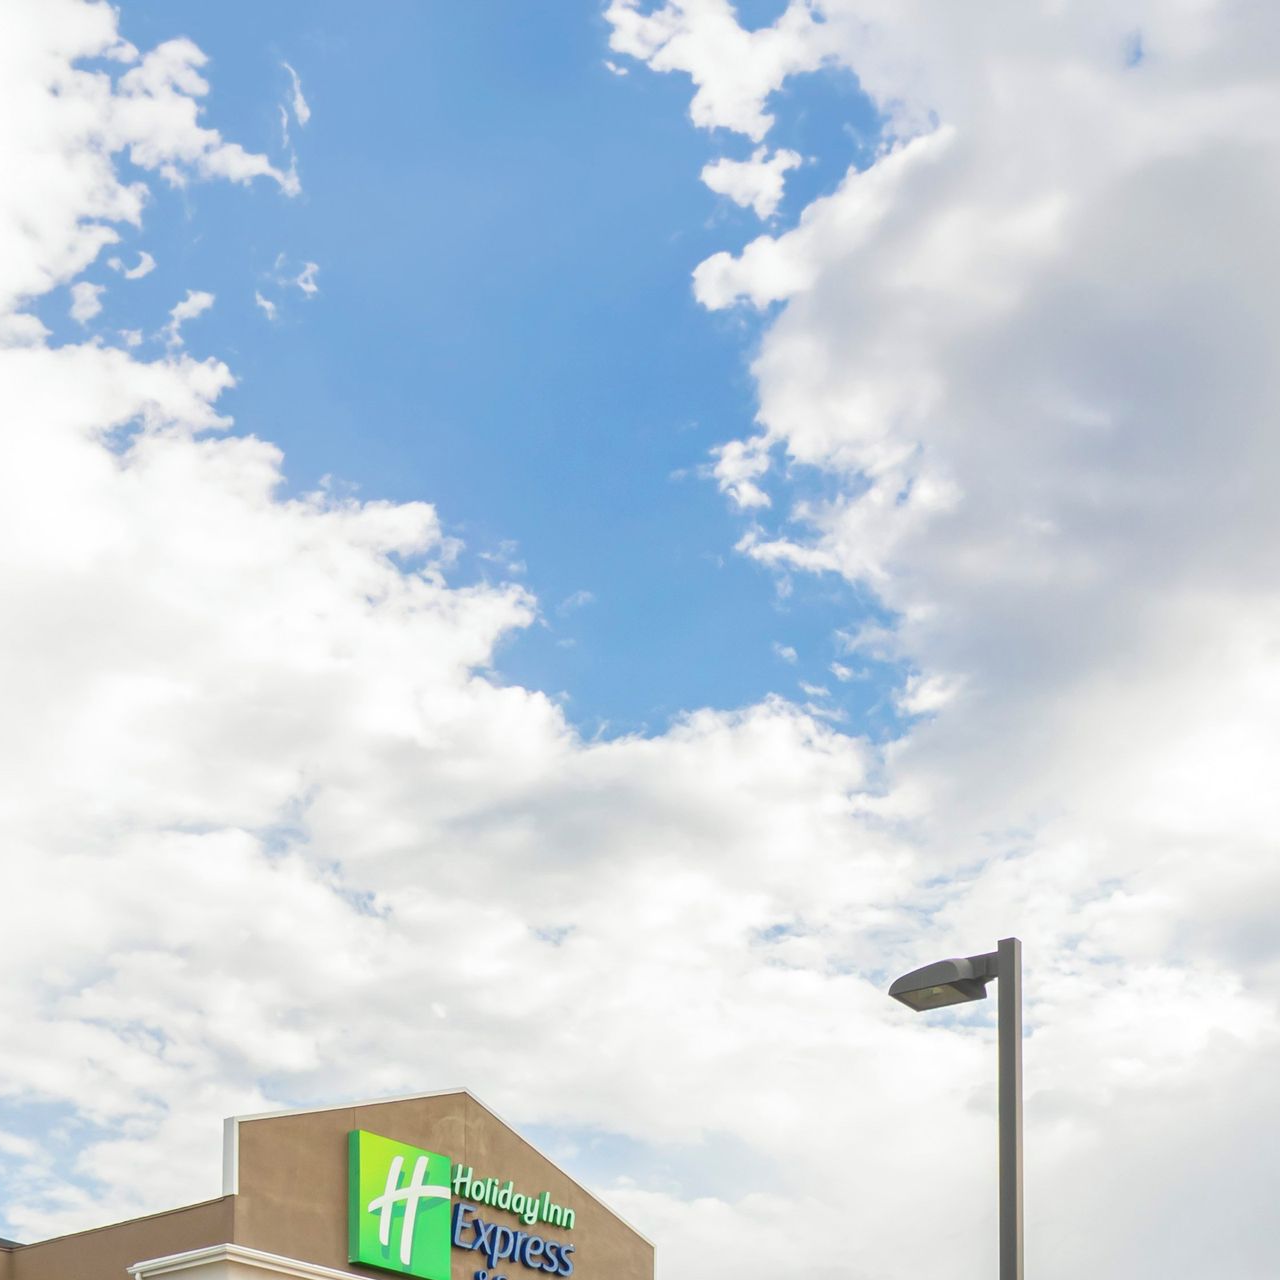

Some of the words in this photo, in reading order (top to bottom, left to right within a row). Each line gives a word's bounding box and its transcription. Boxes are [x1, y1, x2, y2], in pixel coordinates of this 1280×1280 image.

[451, 1163, 540, 1225] Holiday
[539, 1191, 576, 1229] Inn
[451, 1202, 575, 1277] Express
